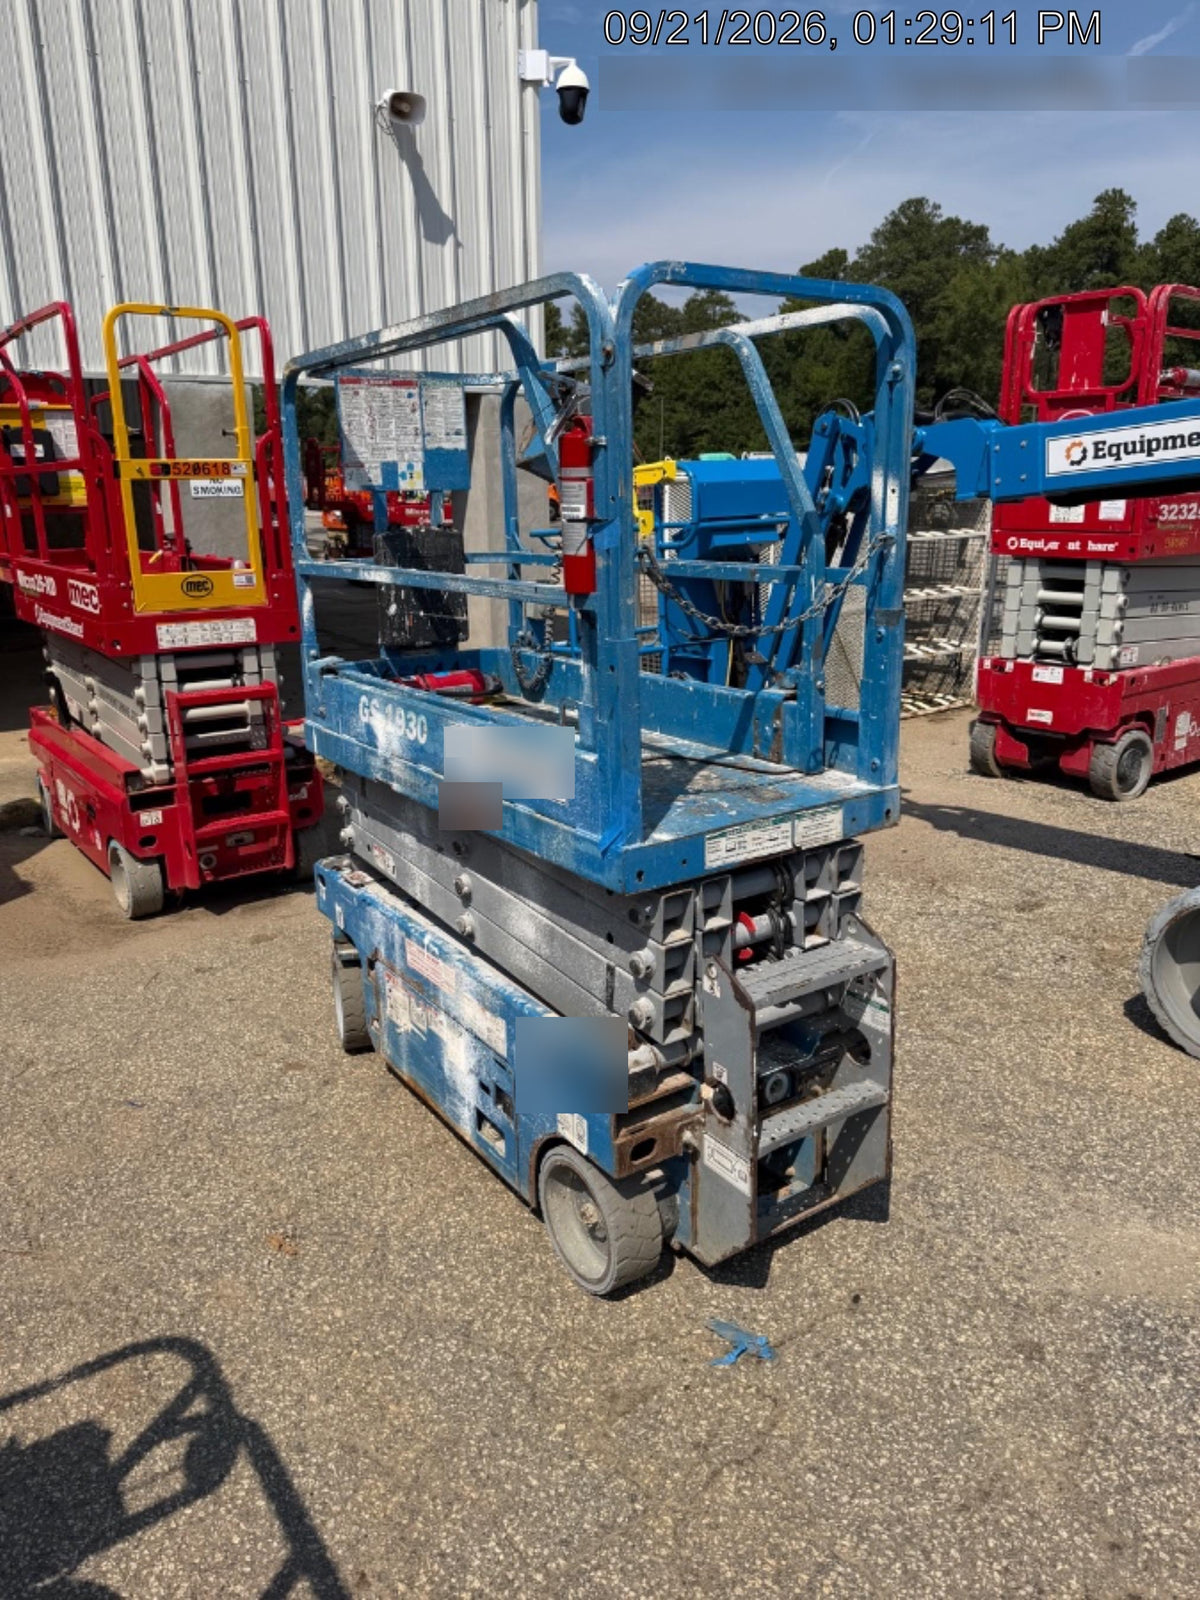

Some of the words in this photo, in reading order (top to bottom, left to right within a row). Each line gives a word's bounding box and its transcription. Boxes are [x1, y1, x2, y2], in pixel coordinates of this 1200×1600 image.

[172, 462, 231, 476] 520618
[192, 486, 242, 495] SMOKING
[1159, 503, 1200, 520] 3232
[185, 580, 210, 593] mec
